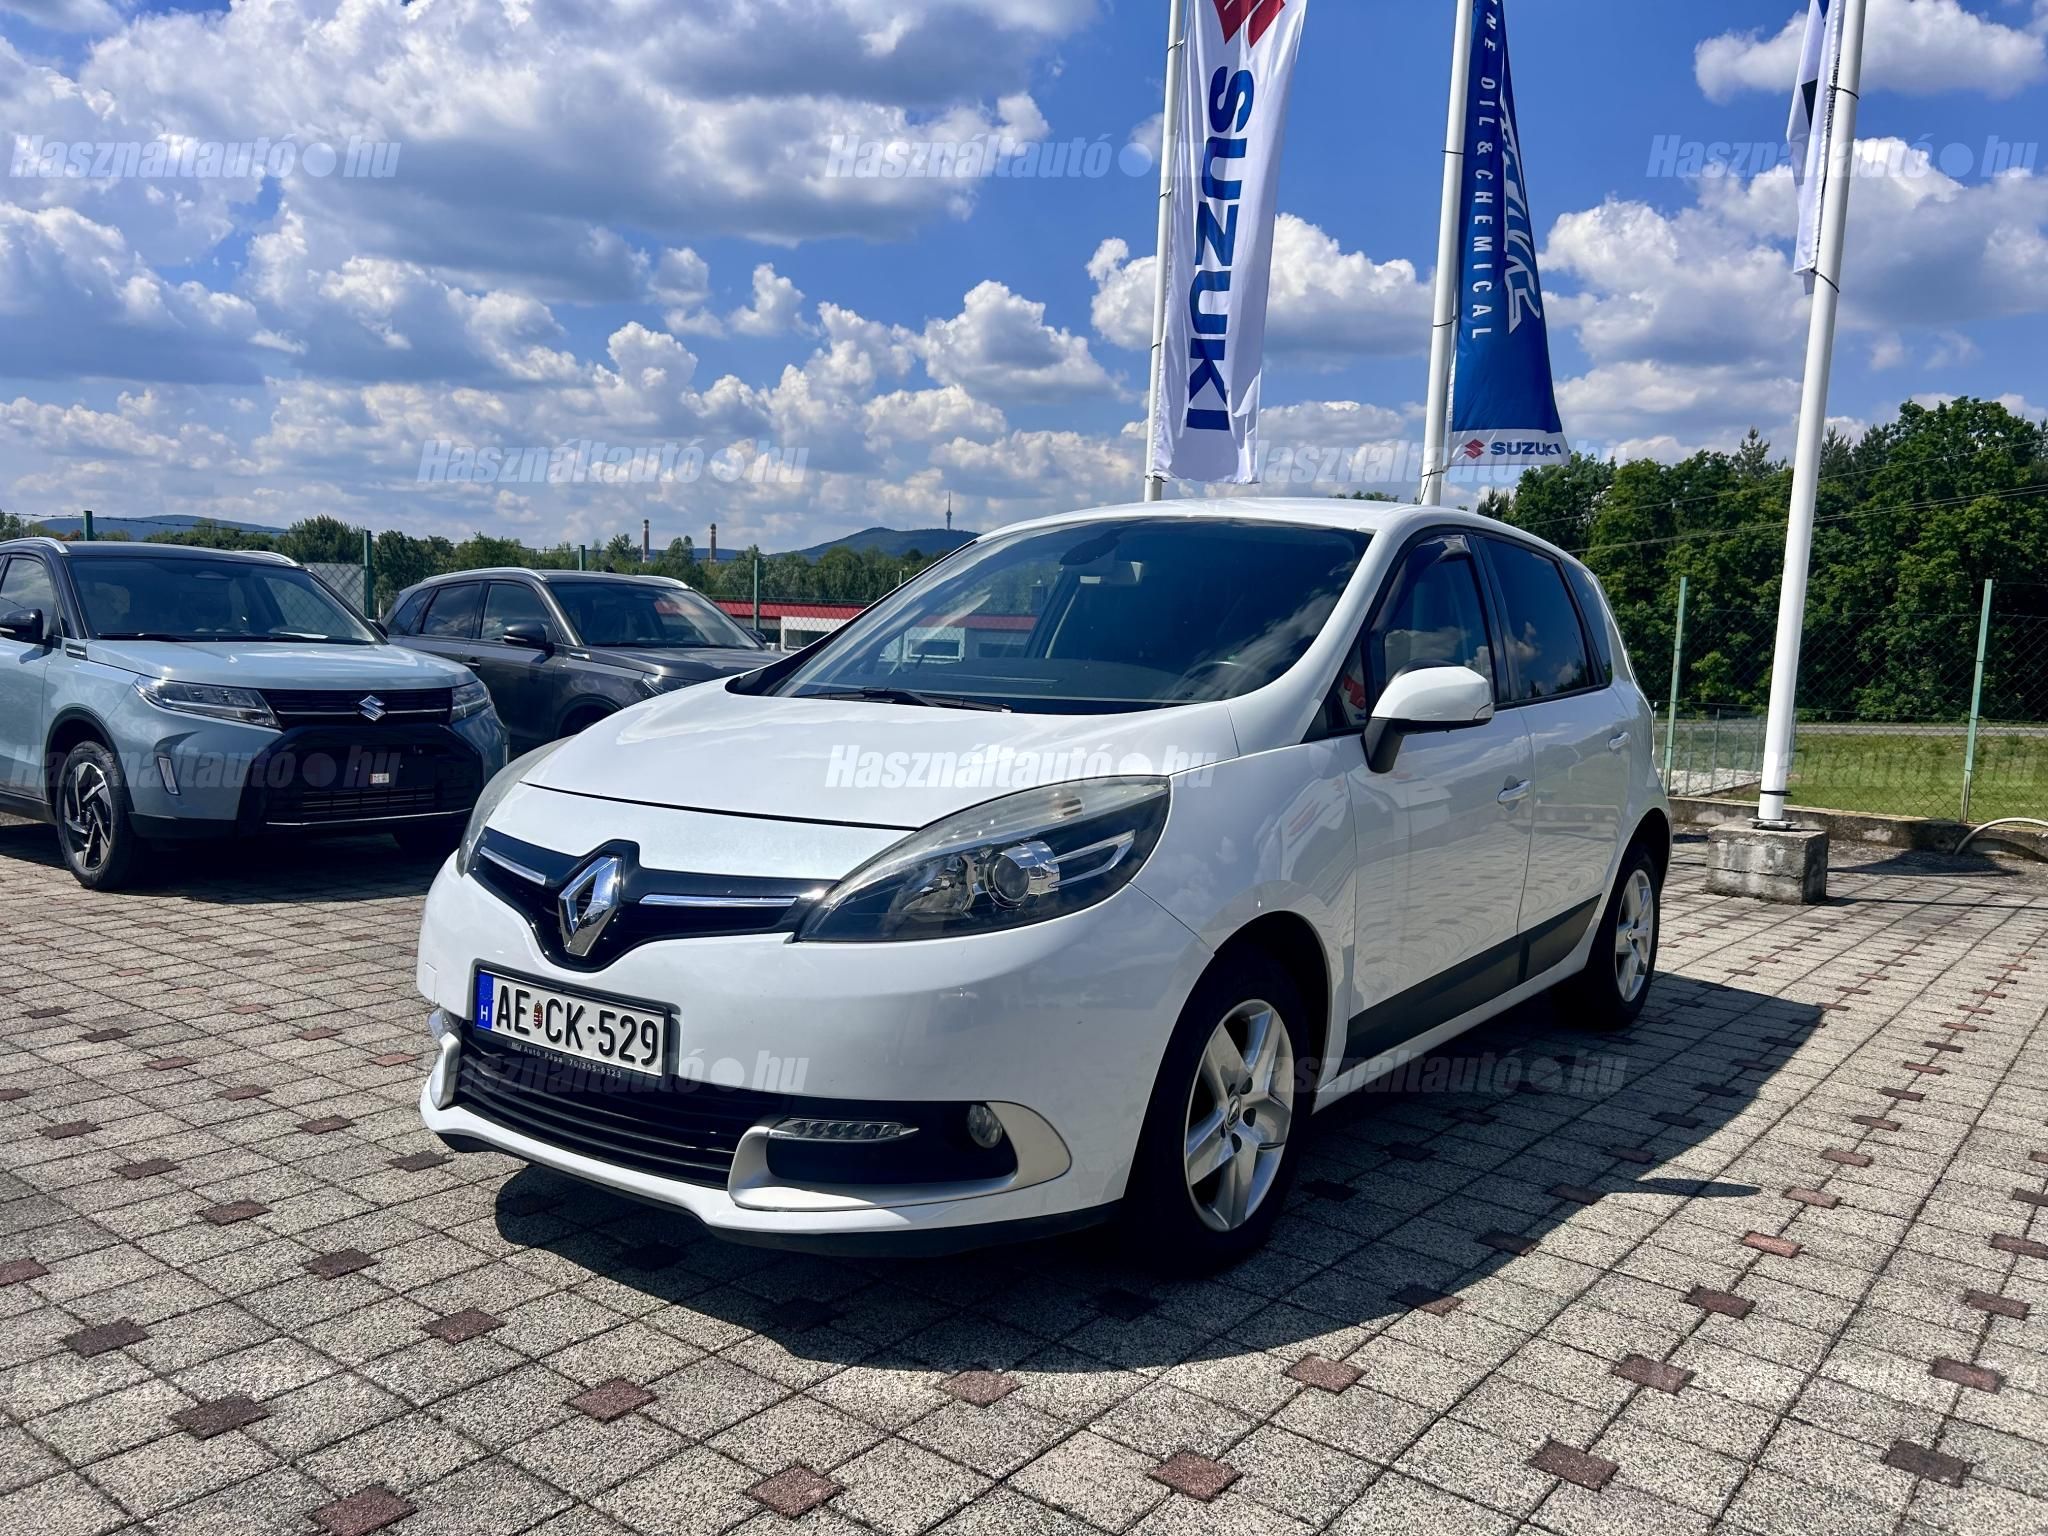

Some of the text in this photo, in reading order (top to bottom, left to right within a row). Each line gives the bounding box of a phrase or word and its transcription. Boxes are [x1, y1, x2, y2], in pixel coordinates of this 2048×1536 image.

[1187, 66, 1254, 431] SUZUKI
[1490, 441, 1562, 456] SUZUKI
[480, 1005, 489, 1022] H
